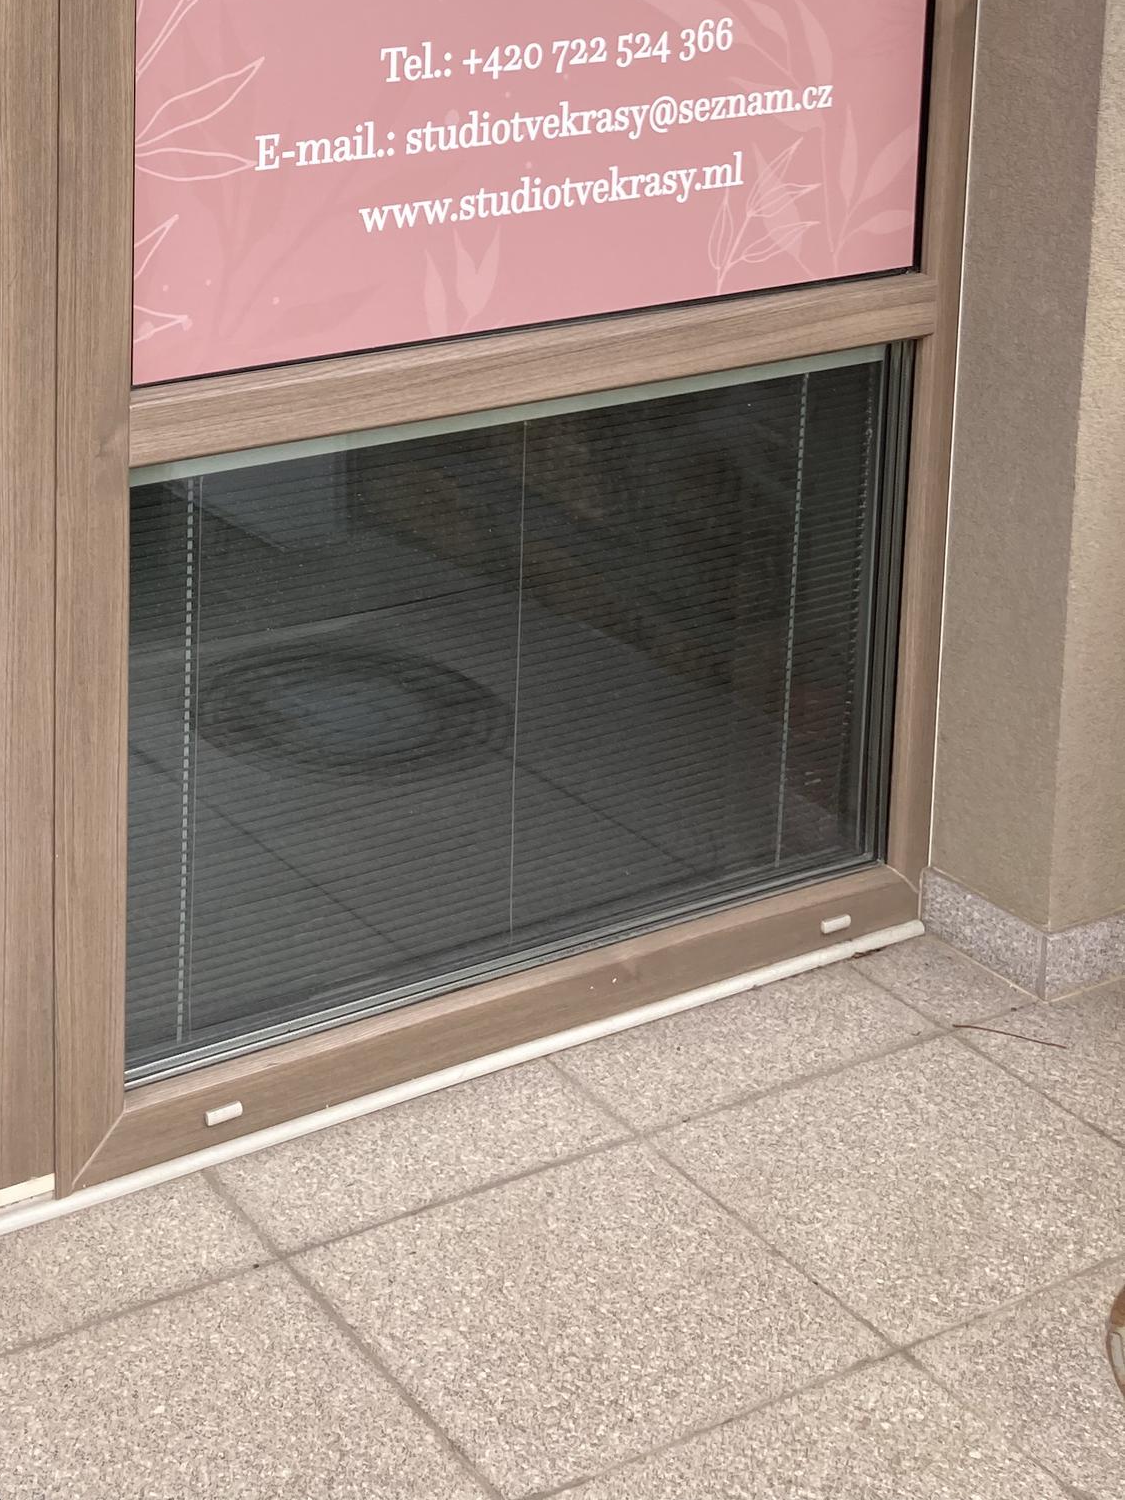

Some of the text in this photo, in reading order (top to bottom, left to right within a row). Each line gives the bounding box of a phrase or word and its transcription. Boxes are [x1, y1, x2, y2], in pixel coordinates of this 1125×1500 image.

[380, 17, 734, 83] Tel.: +420 722 524 366
[255, 84, 833, 171] E-mail.: studiotvekrasy@seznam.cz
[359, 151, 744, 232] www.studiotvekrasy.ml
